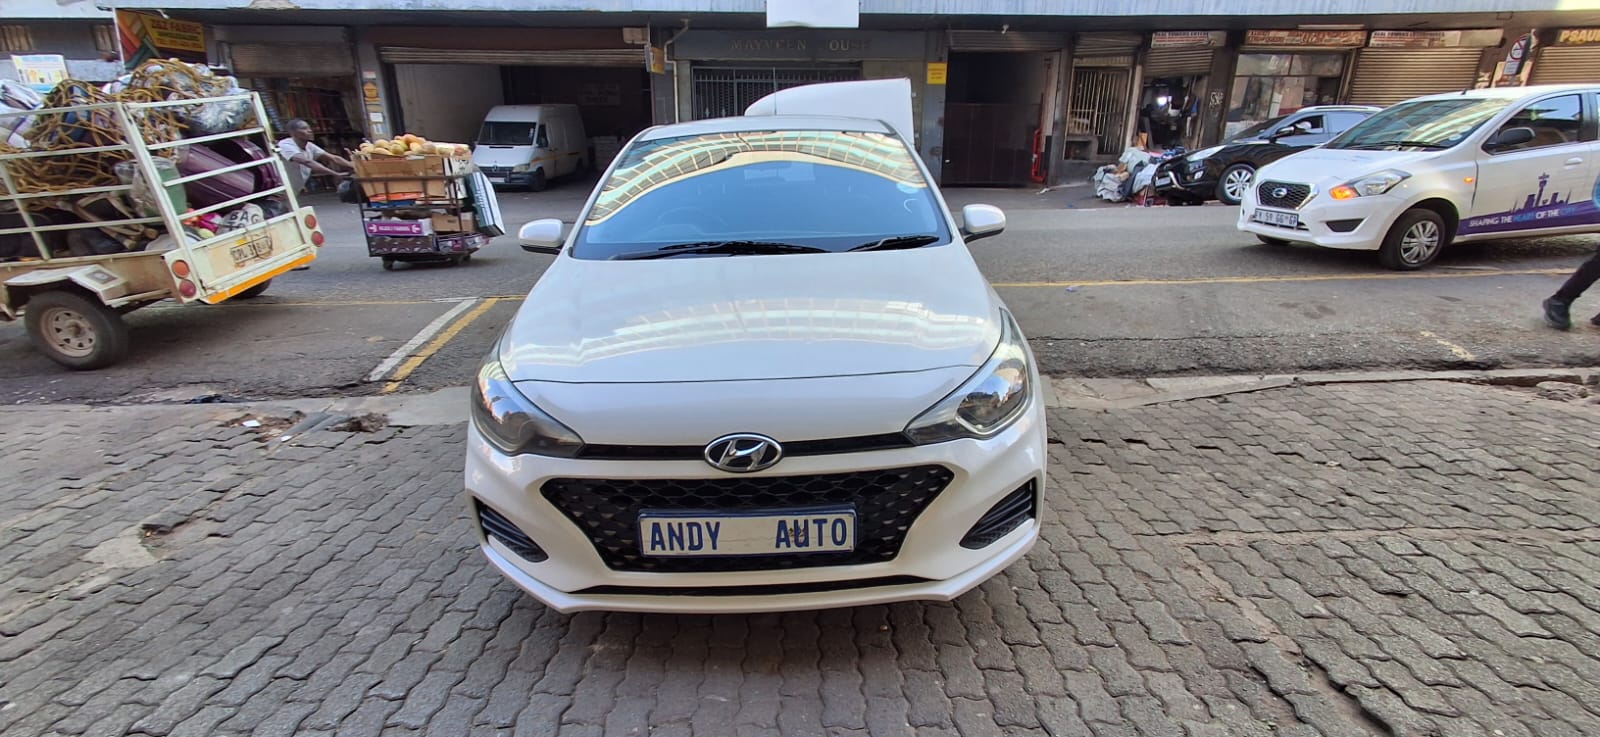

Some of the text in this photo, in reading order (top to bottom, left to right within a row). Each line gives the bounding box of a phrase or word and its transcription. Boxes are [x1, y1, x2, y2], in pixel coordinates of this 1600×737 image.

[230, 211, 260, 225] BAG
[1468, 217, 1499, 227] SHARING
[1501, 215, 1513, 224] THE
[1548, 209, 1560, 217] THE
[650, 518, 848, 551] ANDY AUTO
